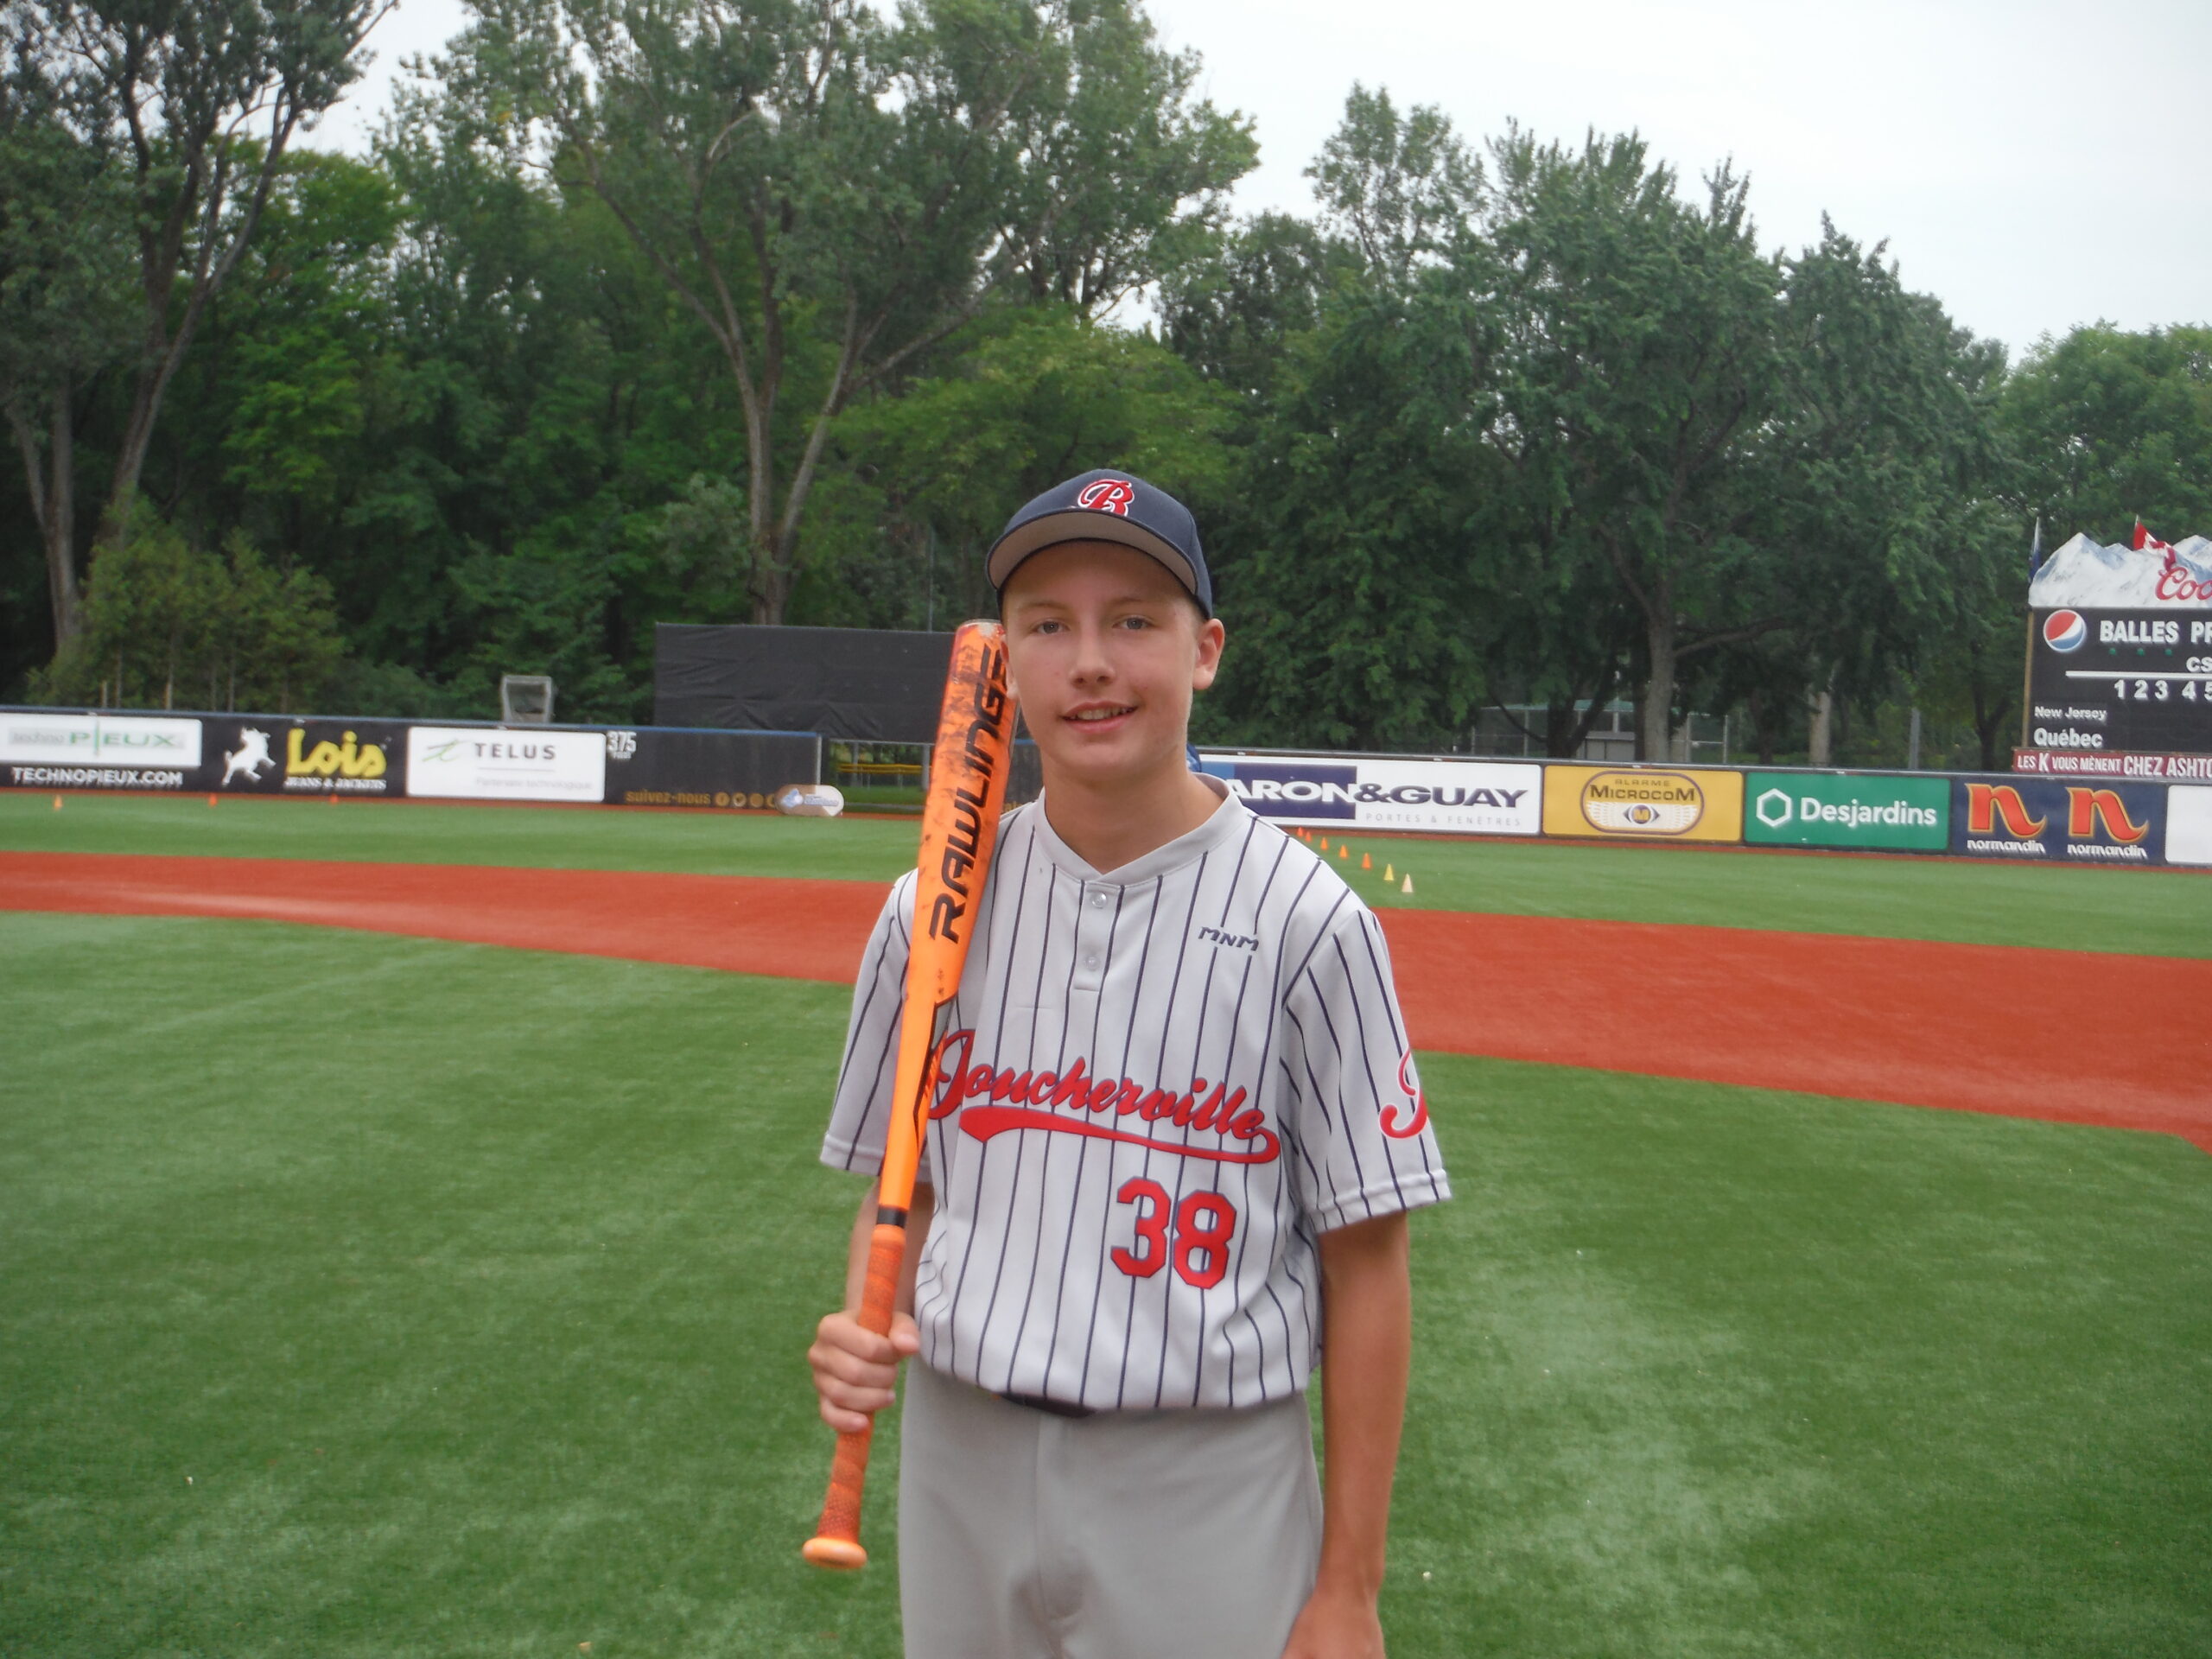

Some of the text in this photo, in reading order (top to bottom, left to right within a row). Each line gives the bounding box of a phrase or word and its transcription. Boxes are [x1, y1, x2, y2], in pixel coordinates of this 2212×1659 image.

[2100, 620, 2179, 644] BALLES
[2113, 679, 2126, 700] 1
[2134, 679, 2148, 700] 2
[2154, 679, 2169, 700] 3
[2182, 680, 2196, 702] 4
[2034, 706, 2107, 723] New Jersey
[607, 731, 637, 753] 375
[2033, 728, 2103, 748] Québec
[285, 728, 387, 778] Lois
[474, 742, 556, 760] TELUS
[2017, 755, 2036, 769] LES
[2038, 753, 2050, 772] K
[2052, 756, 2078, 771] VOUS
[2080, 755, 2121, 773] MÈNENT
[2123, 755, 2163, 776] CHEZ
[12, 766, 183, 787] TECHNOPIEUX.COM
[626, 789, 711, 804] suivez-nous
[929, 643, 1007, 944] RAWLINGS
[1801, 797, 1936, 827] Desjardins
[1967, 839, 2045, 855] normandin
[2067, 843, 2148, 860] normandin
[1198, 926, 1259, 951] MNM
[1109, 1175, 1237, 1290] 38
